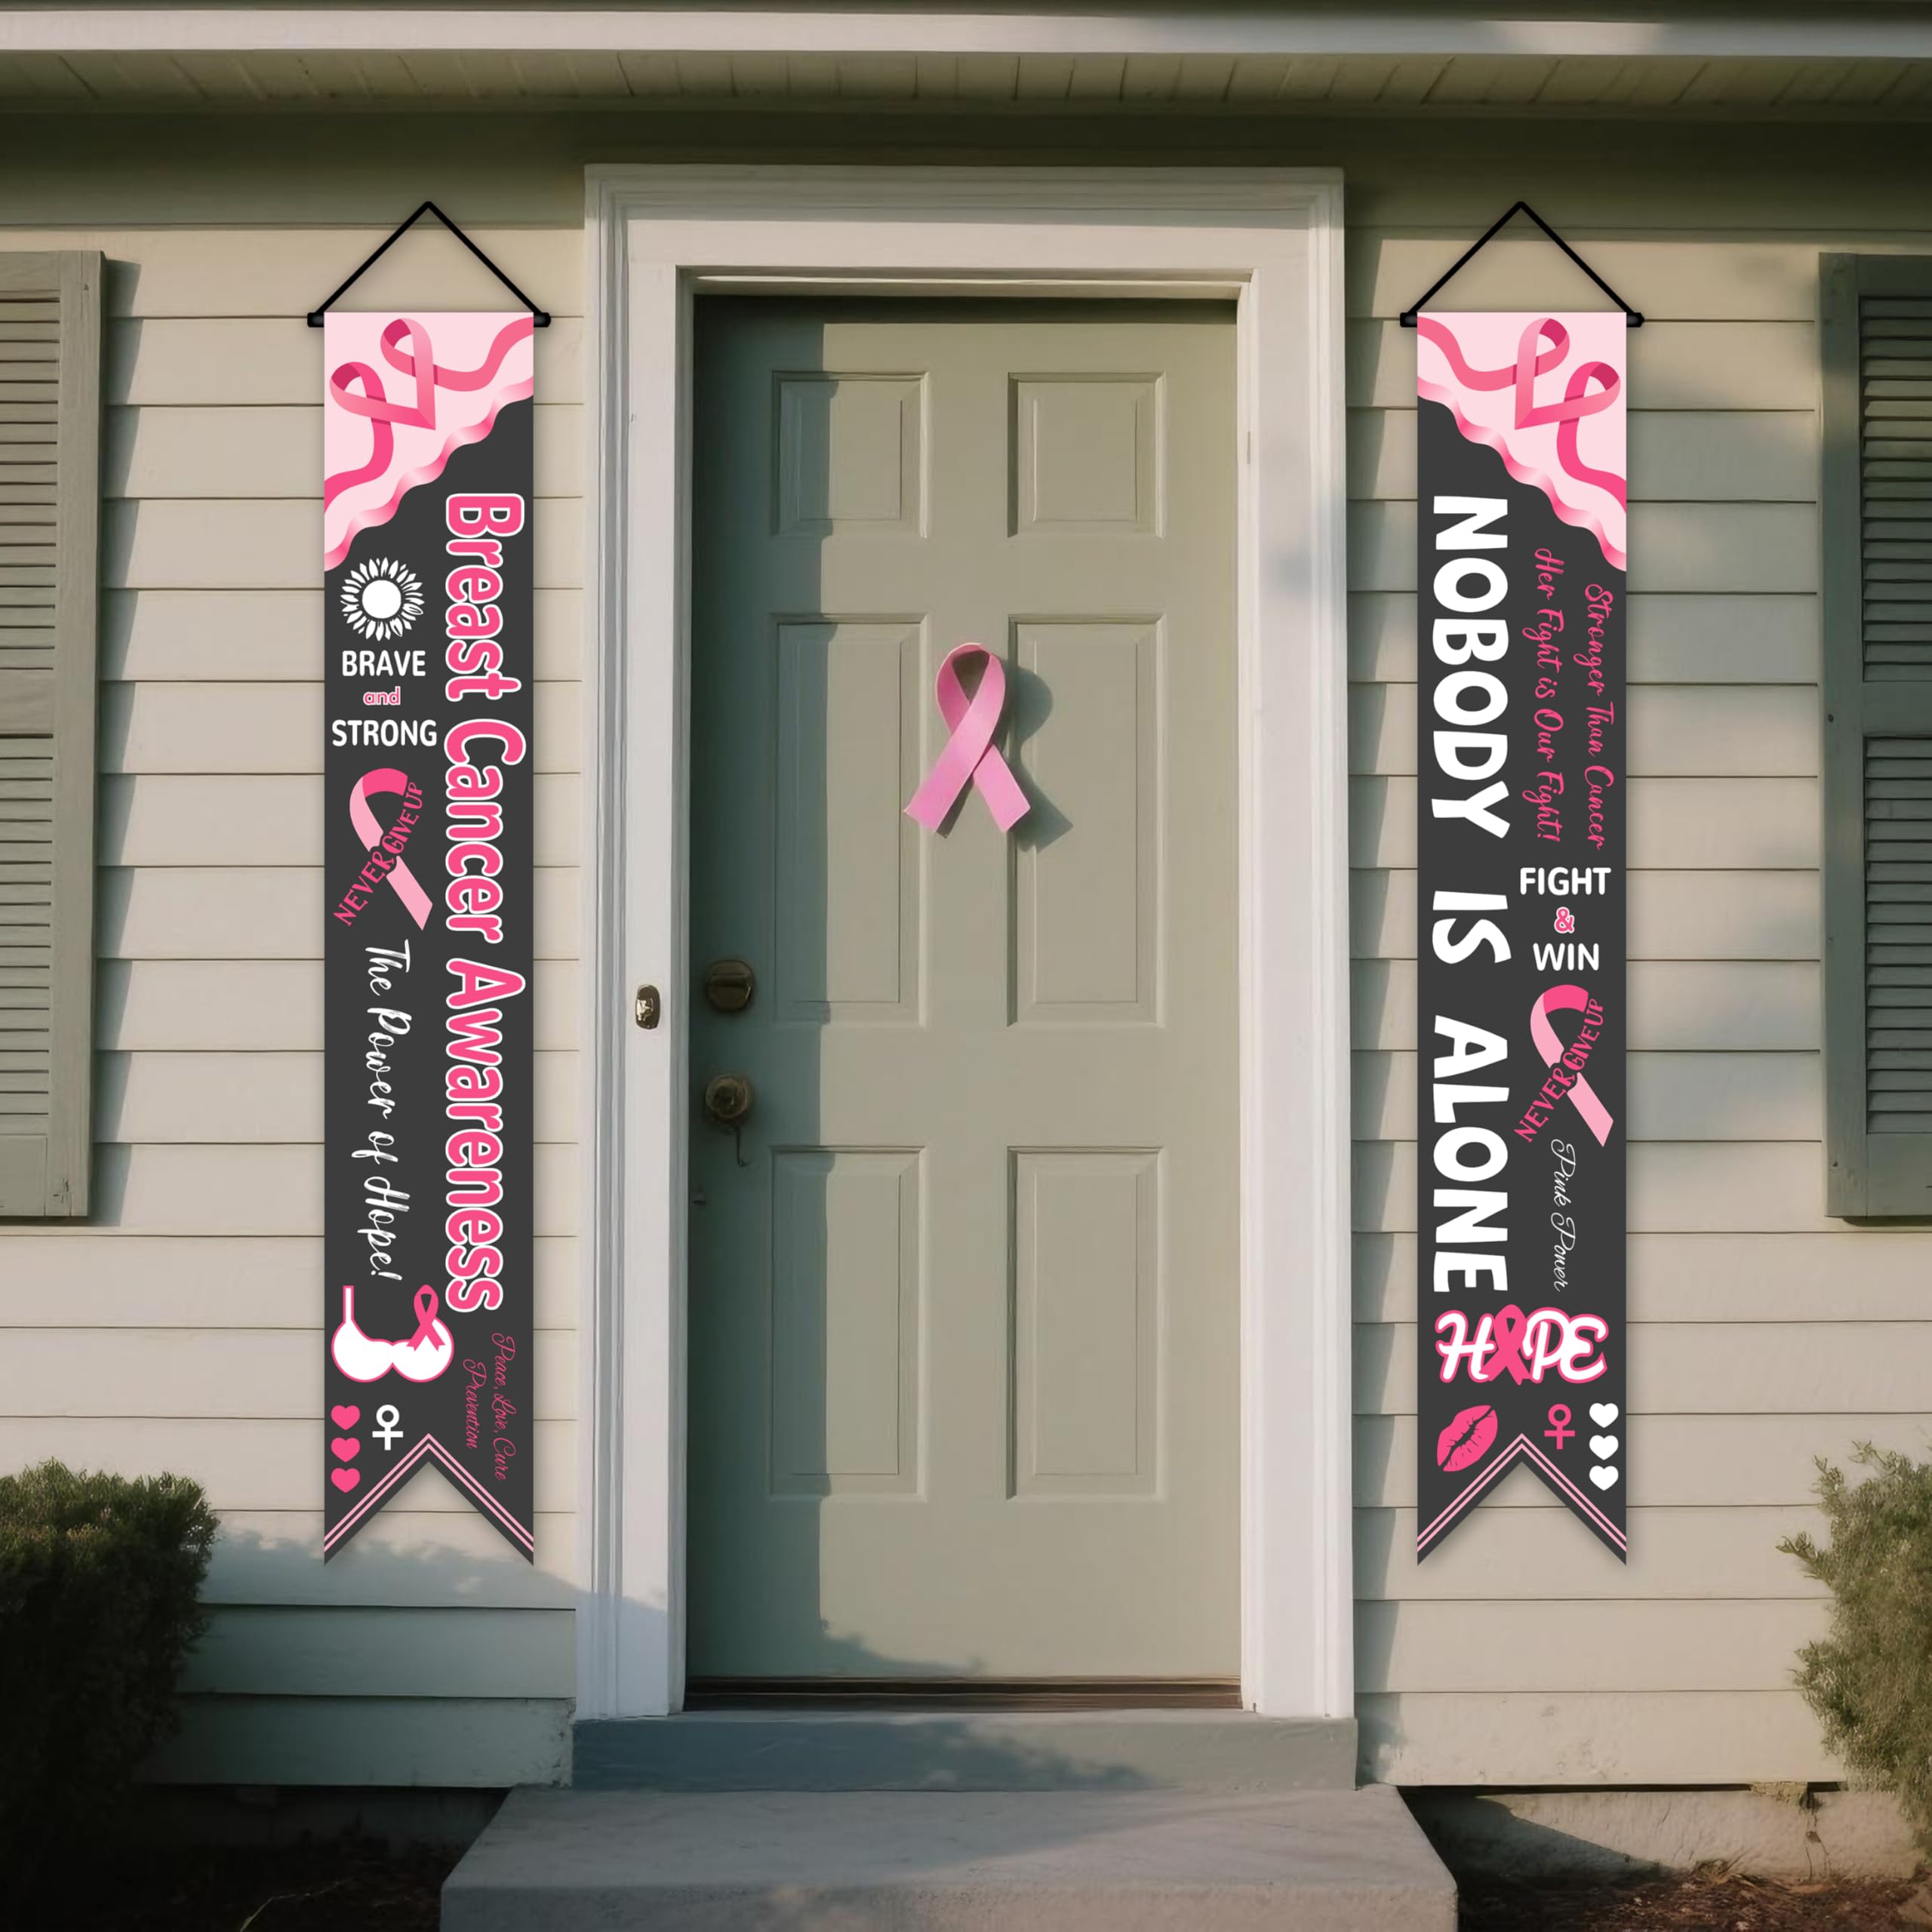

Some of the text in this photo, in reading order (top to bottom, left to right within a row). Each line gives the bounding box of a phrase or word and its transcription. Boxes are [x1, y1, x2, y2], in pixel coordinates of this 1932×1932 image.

[343, 650, 426, 676] BRAVE
[363, 686, 401, 706] and
[1522, 548, 1564, 841] Her Fight is Our Fight!
[1573, 583, 1614, 850] Stronger Than Cancer
[332, 719, 437, 746] STRONG
[333, 781, 423, 927] NEVER GIVE UP
[444, 493, 526, 1312] Breast Cancer Awareness
[1431, 496, 1512, 1292] NOBODY IS ALONE
[1520, 867, 1611, 896] FIGHT
[1533, 943, 1599, 971] WIN
[1554, 906, 1575, 934] &
[351, 939, 412, 1280] The Power of Hope!
[1513, 998, 1604, 1143] NEVER GIVE UP
[1551, 1139, 1576, 1291] Pink Power
[463, 1359, 487, 1448] Prevention
[493, 1438, 515, 1479] Cure
